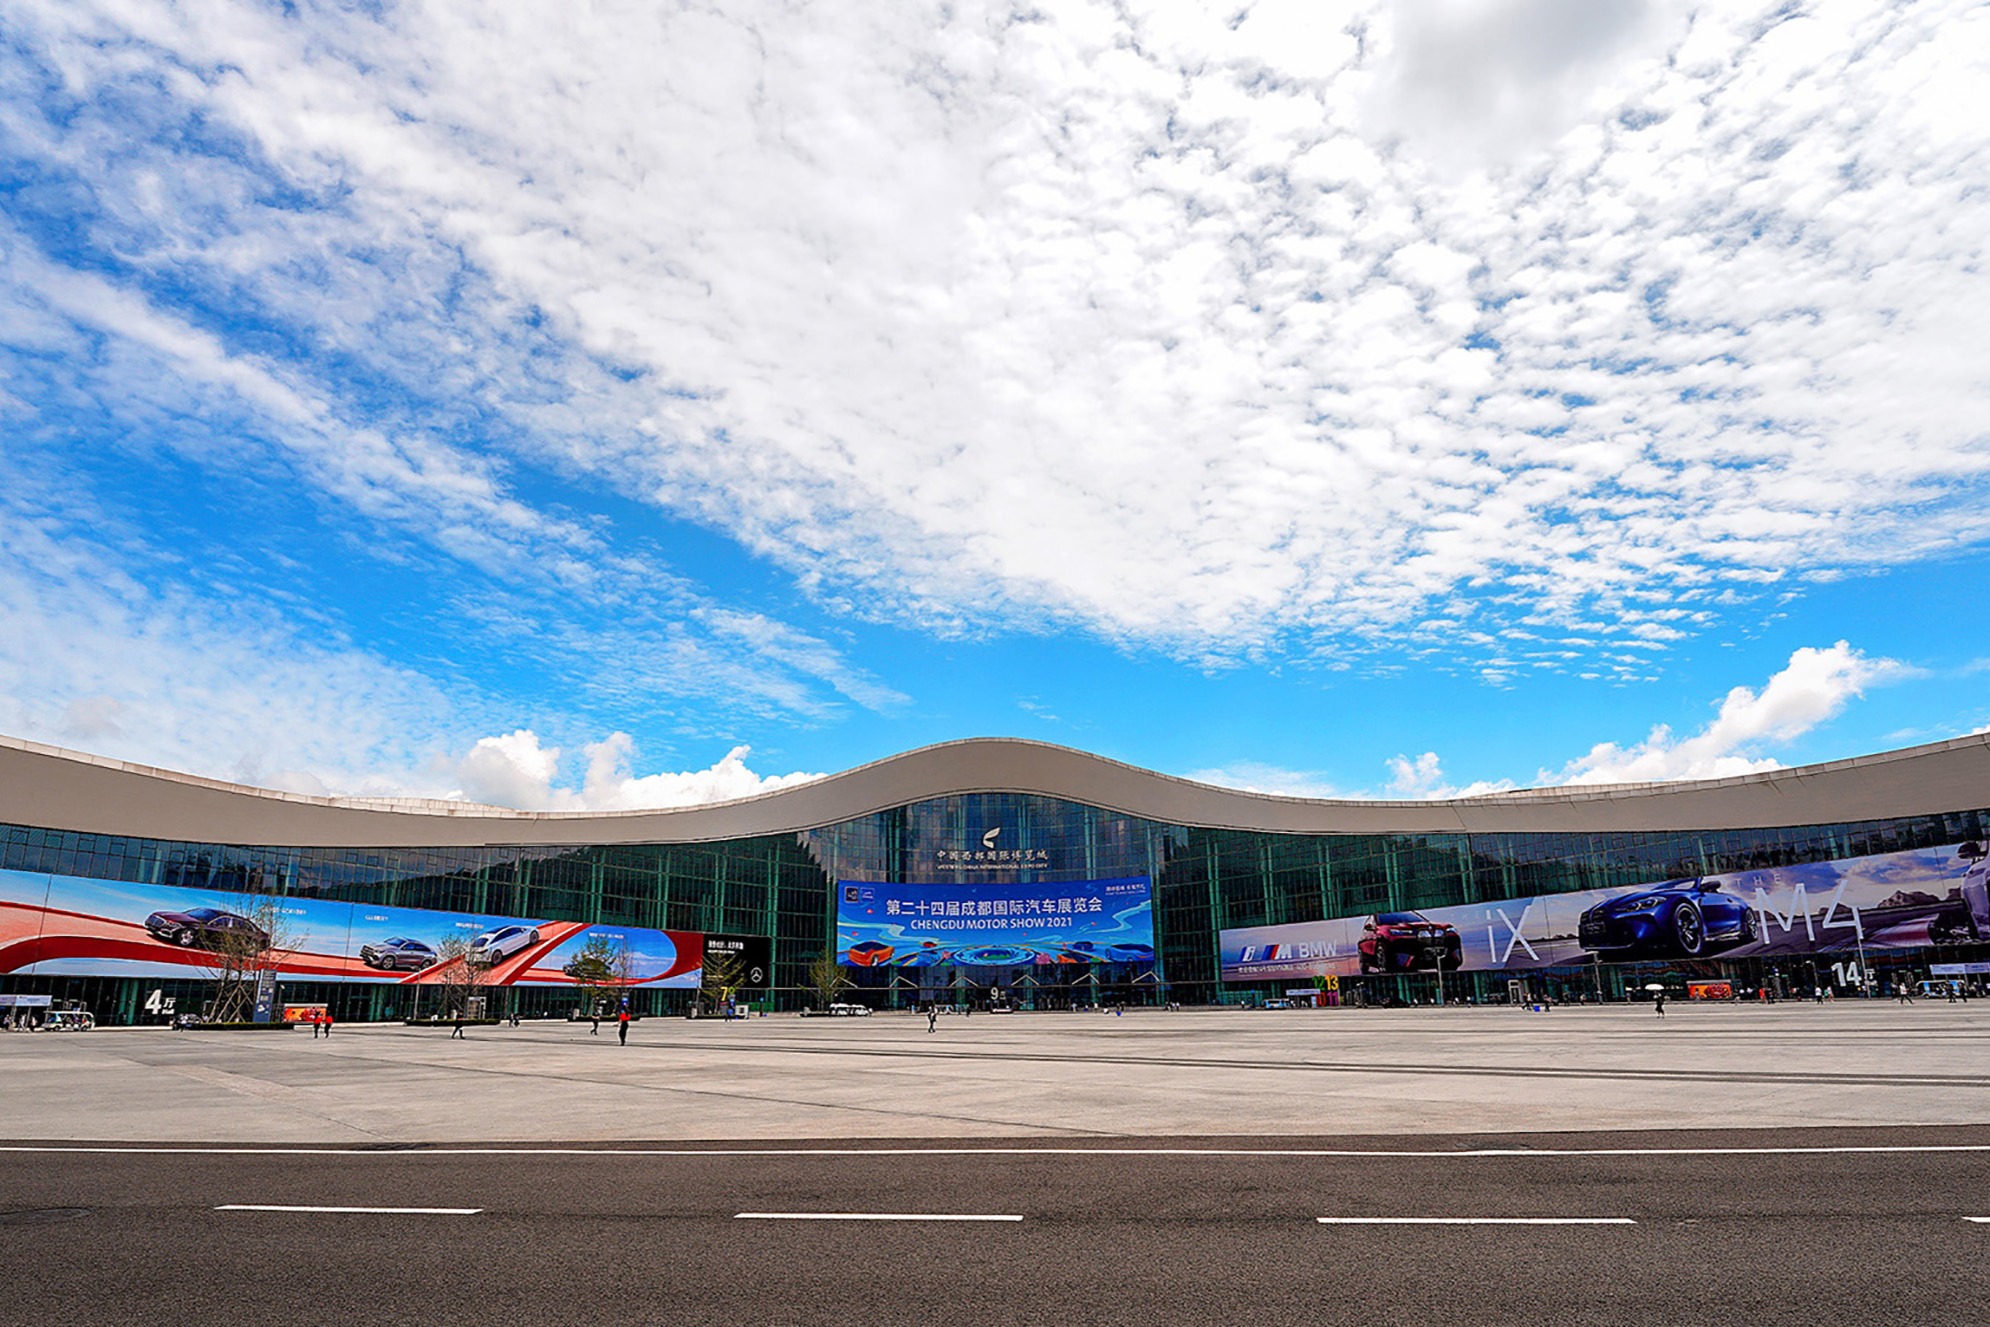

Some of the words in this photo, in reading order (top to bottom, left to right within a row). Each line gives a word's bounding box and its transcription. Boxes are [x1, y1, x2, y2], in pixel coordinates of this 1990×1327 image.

[886, 897, 1103, 916] 第二十四届成都国际汽车展览会
[1755, 880, 1863, 944] M4
[910, 919, 964, 930] CHENGDU
[967, 918, 1008, 930] MOTOR
[1010, 917, 1045, 928] SHOW
[1047, 917, 1072, 927] 2021
[1299, 941, 1336, 957] BMW
[1325, 974, 1339, 990] 13
